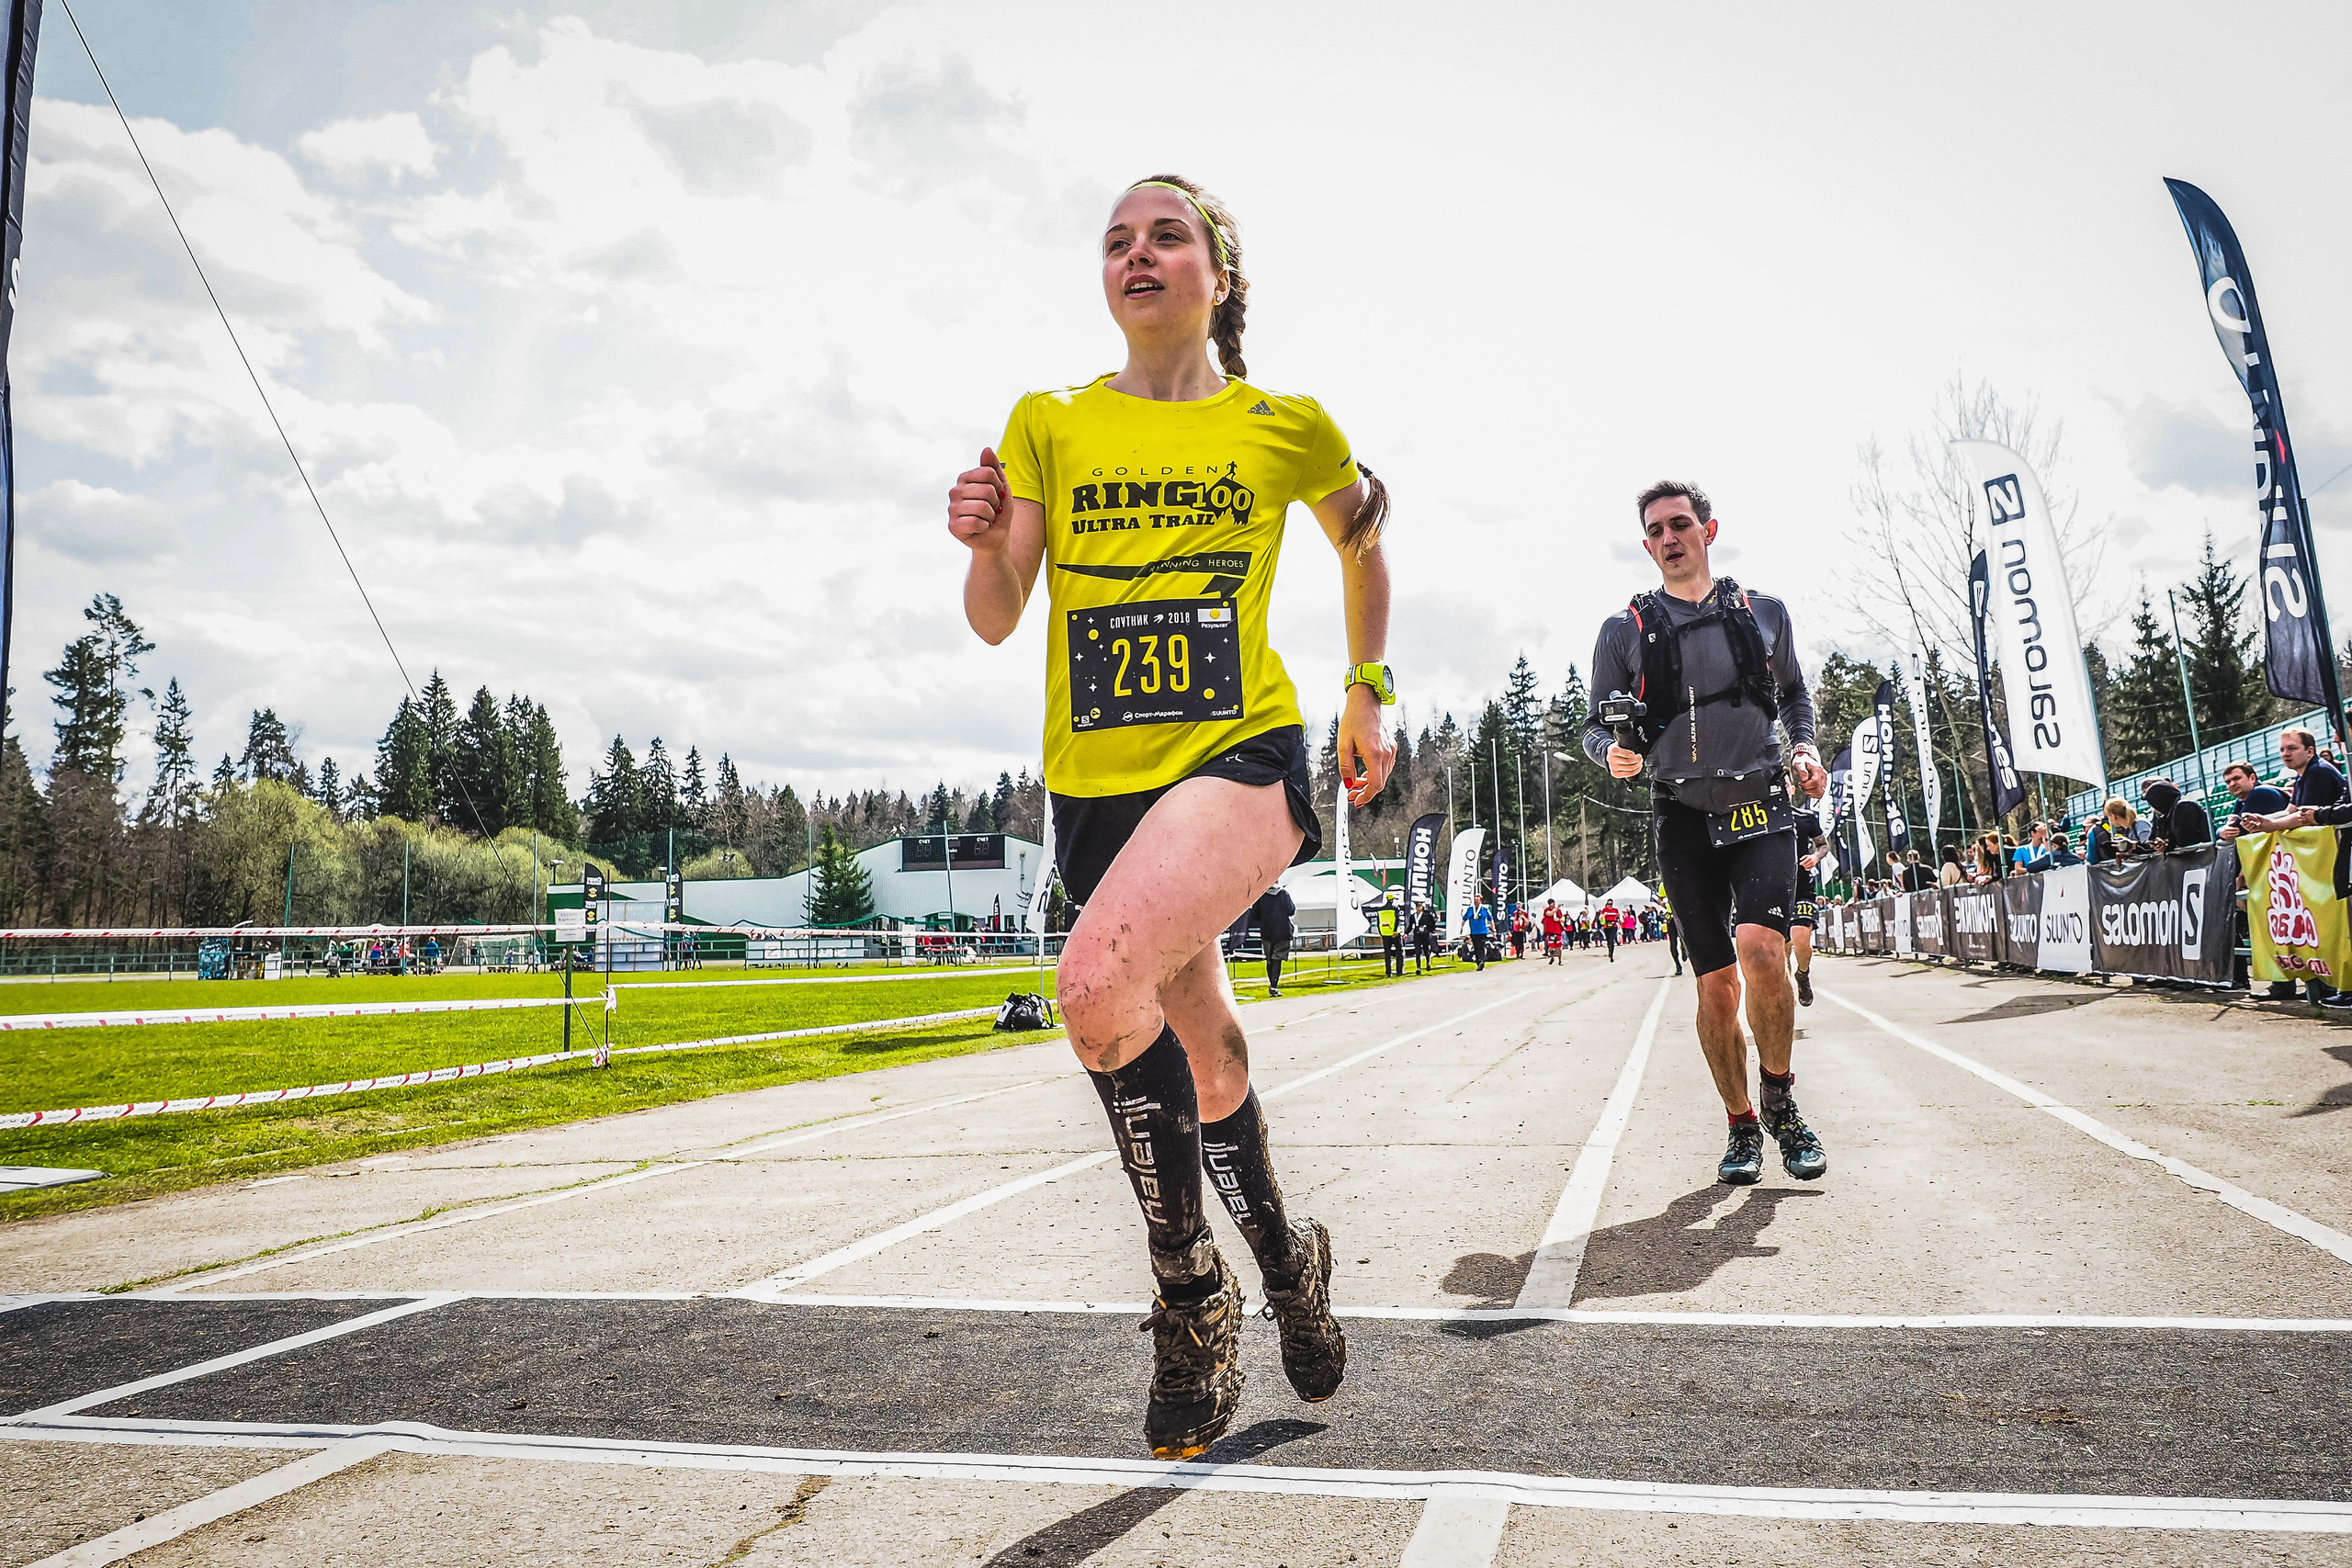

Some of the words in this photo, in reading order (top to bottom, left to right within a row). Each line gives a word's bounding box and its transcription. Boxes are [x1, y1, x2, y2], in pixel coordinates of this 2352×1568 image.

[1091, 465, 1218, 477] GOLDEN
[1071, 480, 1198, 514] RING
[1193, 484, 1252, 512] 100
[1071, 516, 1141, 536] ULTRA
[1148, 513, 1216, 529] TRAIL
[1208, 558, 1244, 568] HEROES
[1110, 614, 1149, 629] СПУТНИК
[1168, 611, 1191, 625] 2018
[1112, 634, 1191, 697] 239
[1497, 862, 1510, 922] SUUNTO
[1796, 904, 1813, 916] 212
[2102, 899, 2179, 947] salomon
[2046, 912, 2084, 944] SUUNTO
